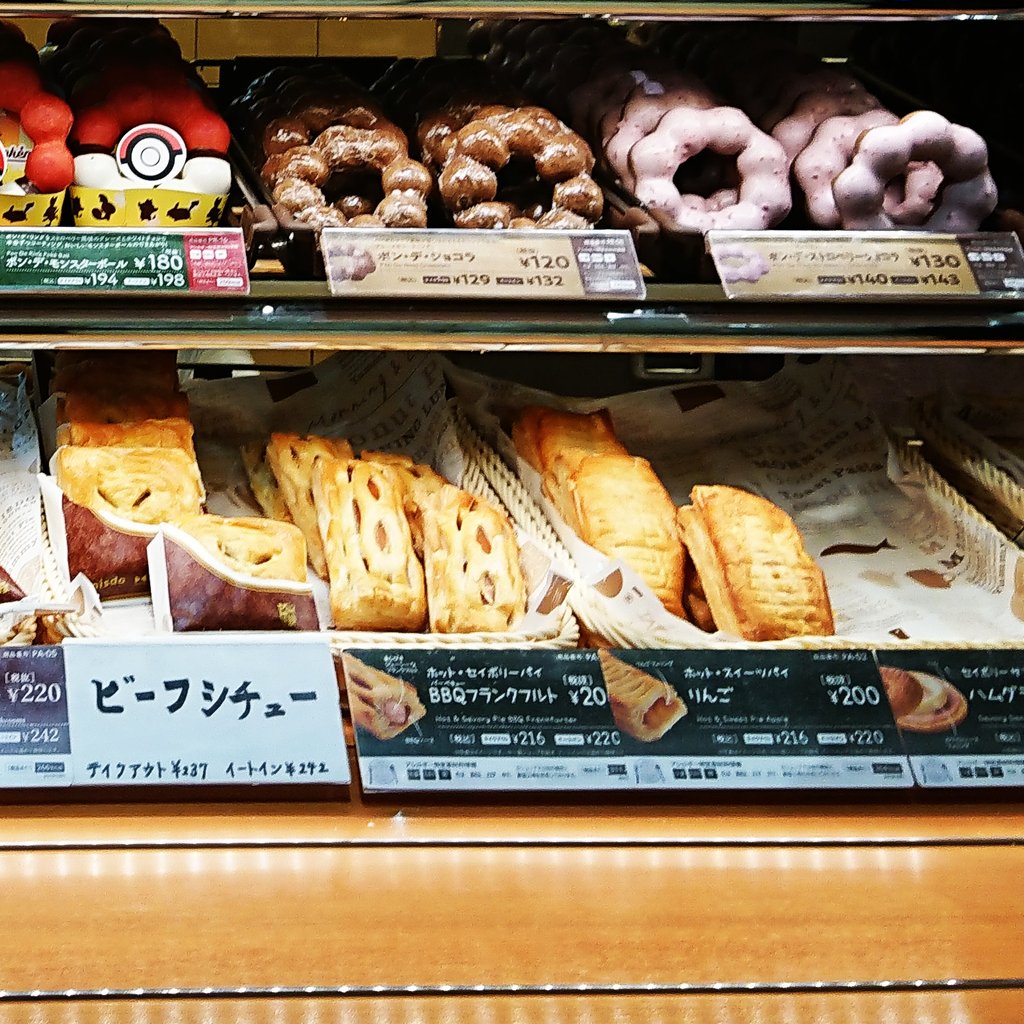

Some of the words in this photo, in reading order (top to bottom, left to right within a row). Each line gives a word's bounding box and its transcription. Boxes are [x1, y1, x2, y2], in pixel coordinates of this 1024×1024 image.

[133, 253, 184, 271] ¥180
[519, 255, 570, 269] ¥120
[909, 254, 961, 269] ¥130
[83, 272, 119, 287] ¥194
[150, 272, 186, 288] ¥198
[7, 682, 62, 705] ¥220
[90, 674, 317, 720] ビーフシチュー
[428, 686, 559, 707] BBQフランクフルト
[687, 686, 735, 705] りんご
[826, 685, 881, 707] ¥200
[22, 727, 62, 744] ¥242
[510, 730, 546, 746] ¥216
[774, 729, 809, 745] ¥216
[848, 729, 884, 745] ¥220
[86, 760, 166, 780] テイクアウト
[170, 759, 208, 780] ¥237
[225, 761, 283, 778] イートイン
[284, 761, 330, 776] ¥242
